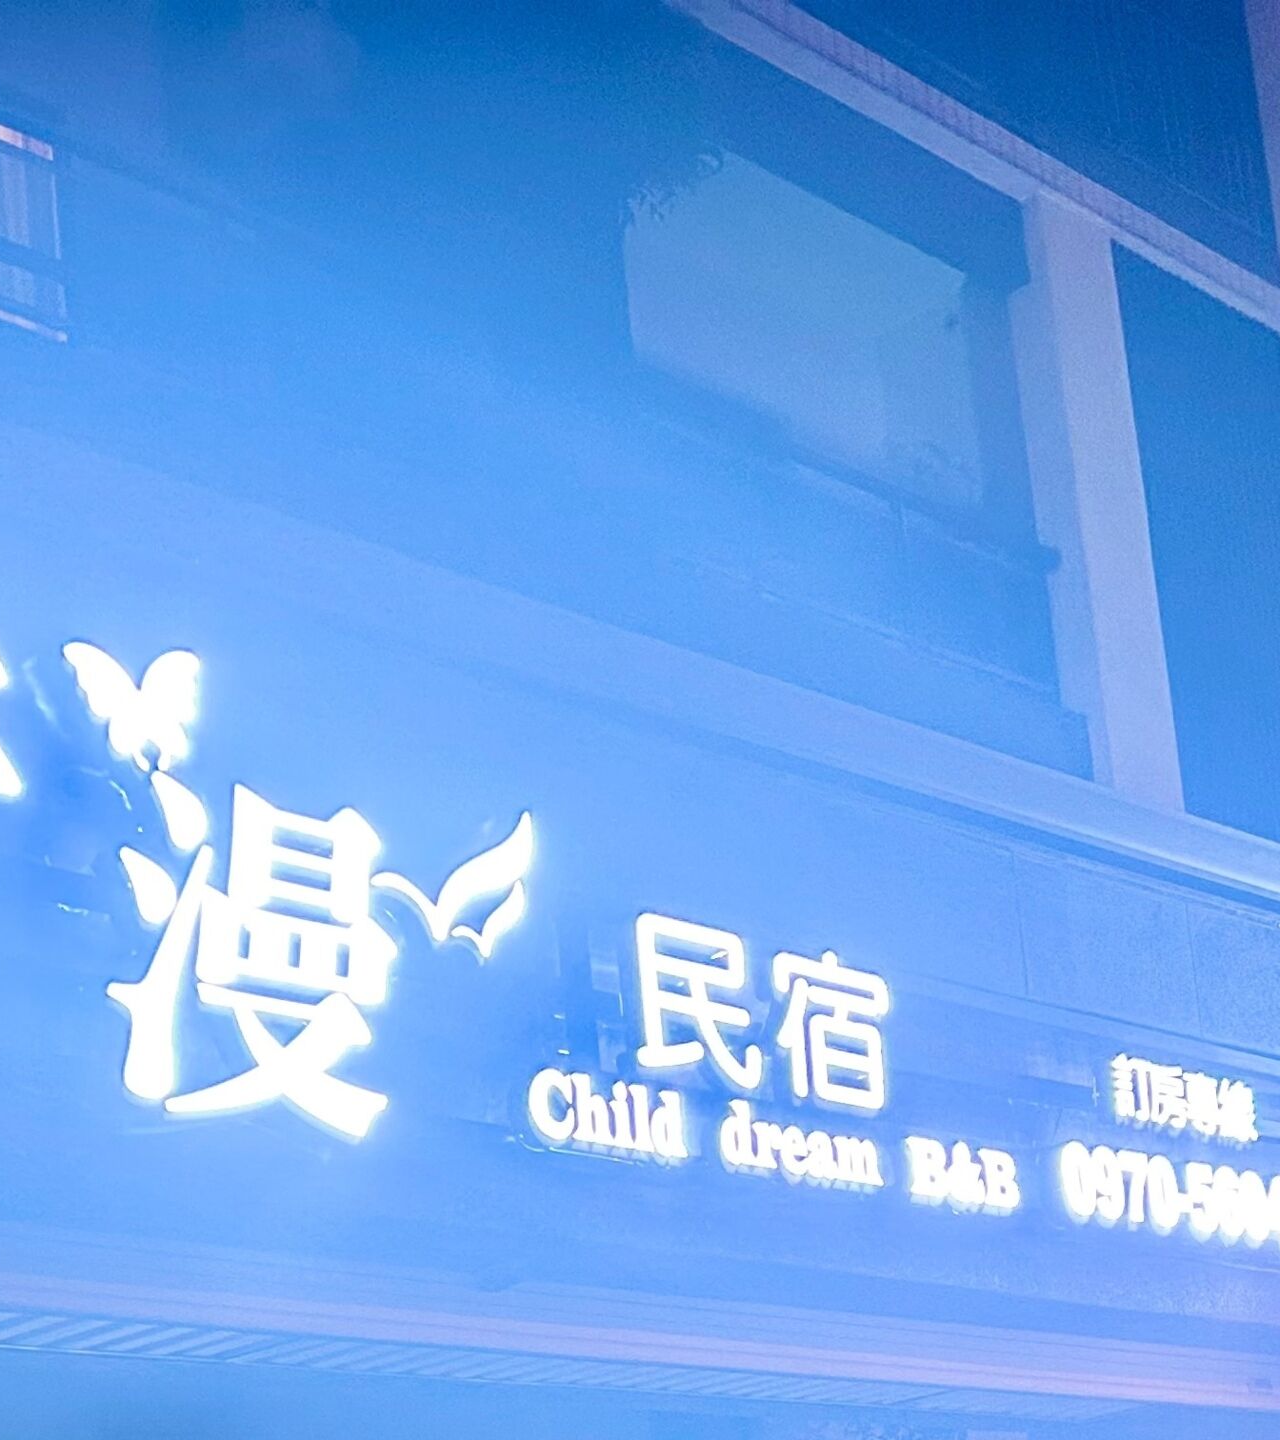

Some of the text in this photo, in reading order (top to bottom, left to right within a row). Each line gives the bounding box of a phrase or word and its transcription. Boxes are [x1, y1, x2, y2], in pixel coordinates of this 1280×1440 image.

[634, 912, 891, 1112] 民宿
[528, 1068, 1021, 1209] Child dream B&B
